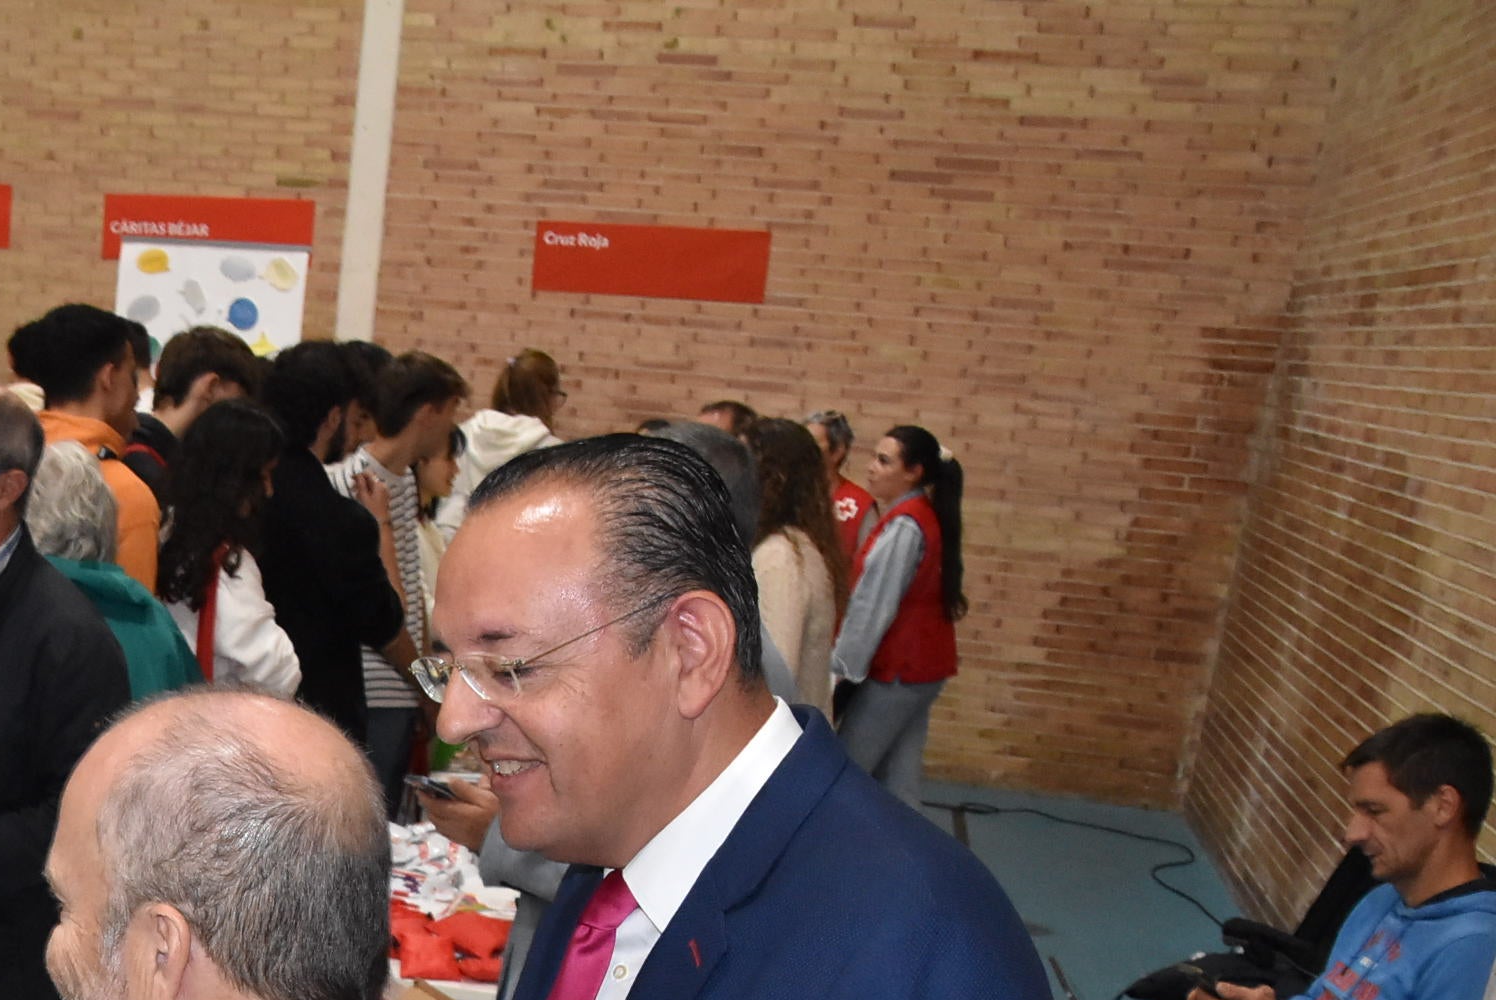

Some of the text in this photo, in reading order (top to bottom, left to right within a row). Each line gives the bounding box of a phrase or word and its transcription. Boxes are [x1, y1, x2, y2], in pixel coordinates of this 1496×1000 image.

[110, 219, 209, 236] CÁRITAS BÉJAR
[543, 230, 609, 251] Cruz Roja
